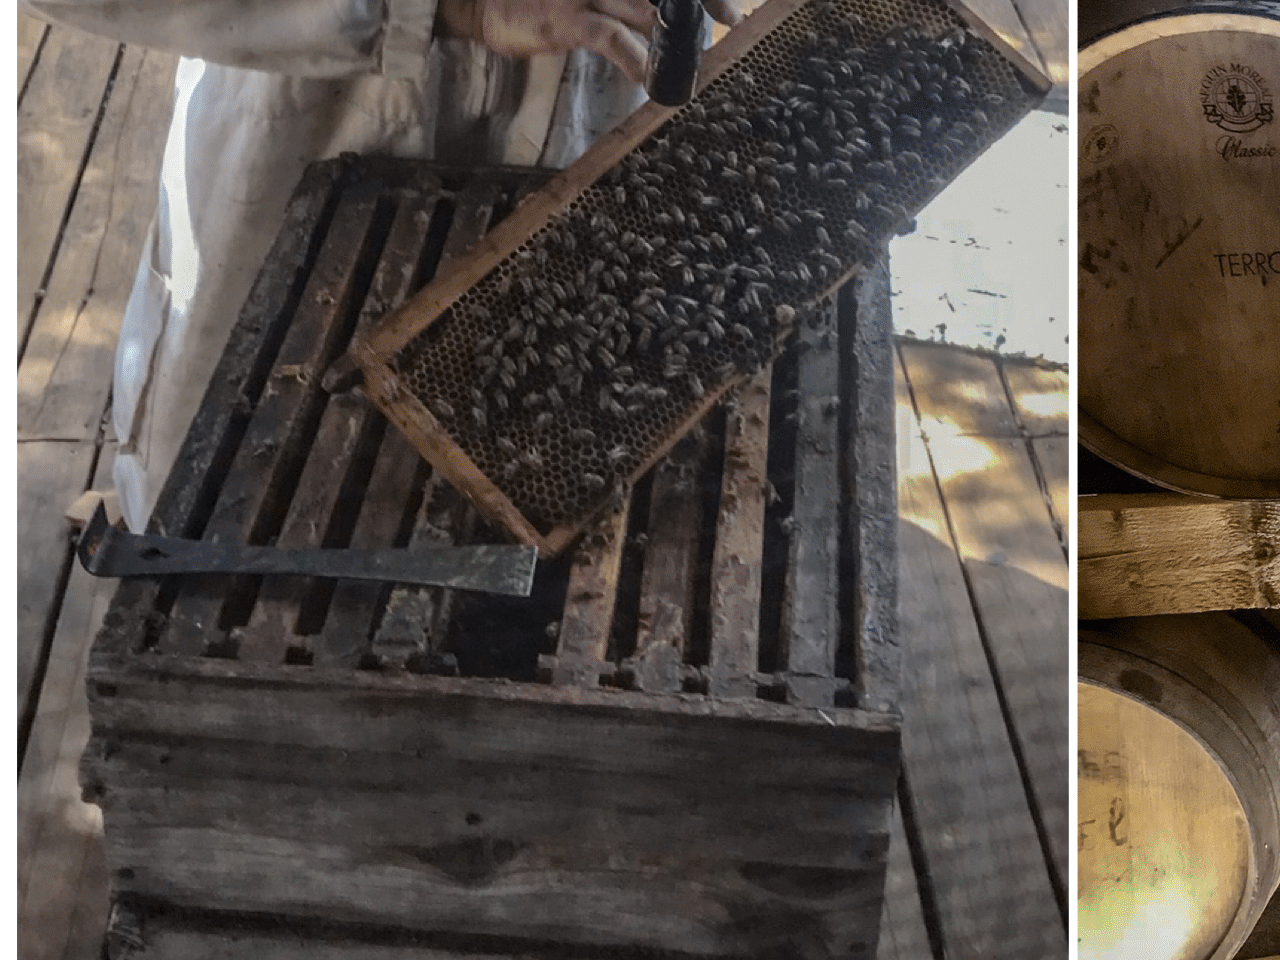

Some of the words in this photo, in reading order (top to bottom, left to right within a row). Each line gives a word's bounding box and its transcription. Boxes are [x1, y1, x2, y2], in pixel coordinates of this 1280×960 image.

[1200, 64, 1227, 104] SEGUIN
[1230, 63, 1273, 103] MOREAU
[1215, 134, 1277, 162] Classic
